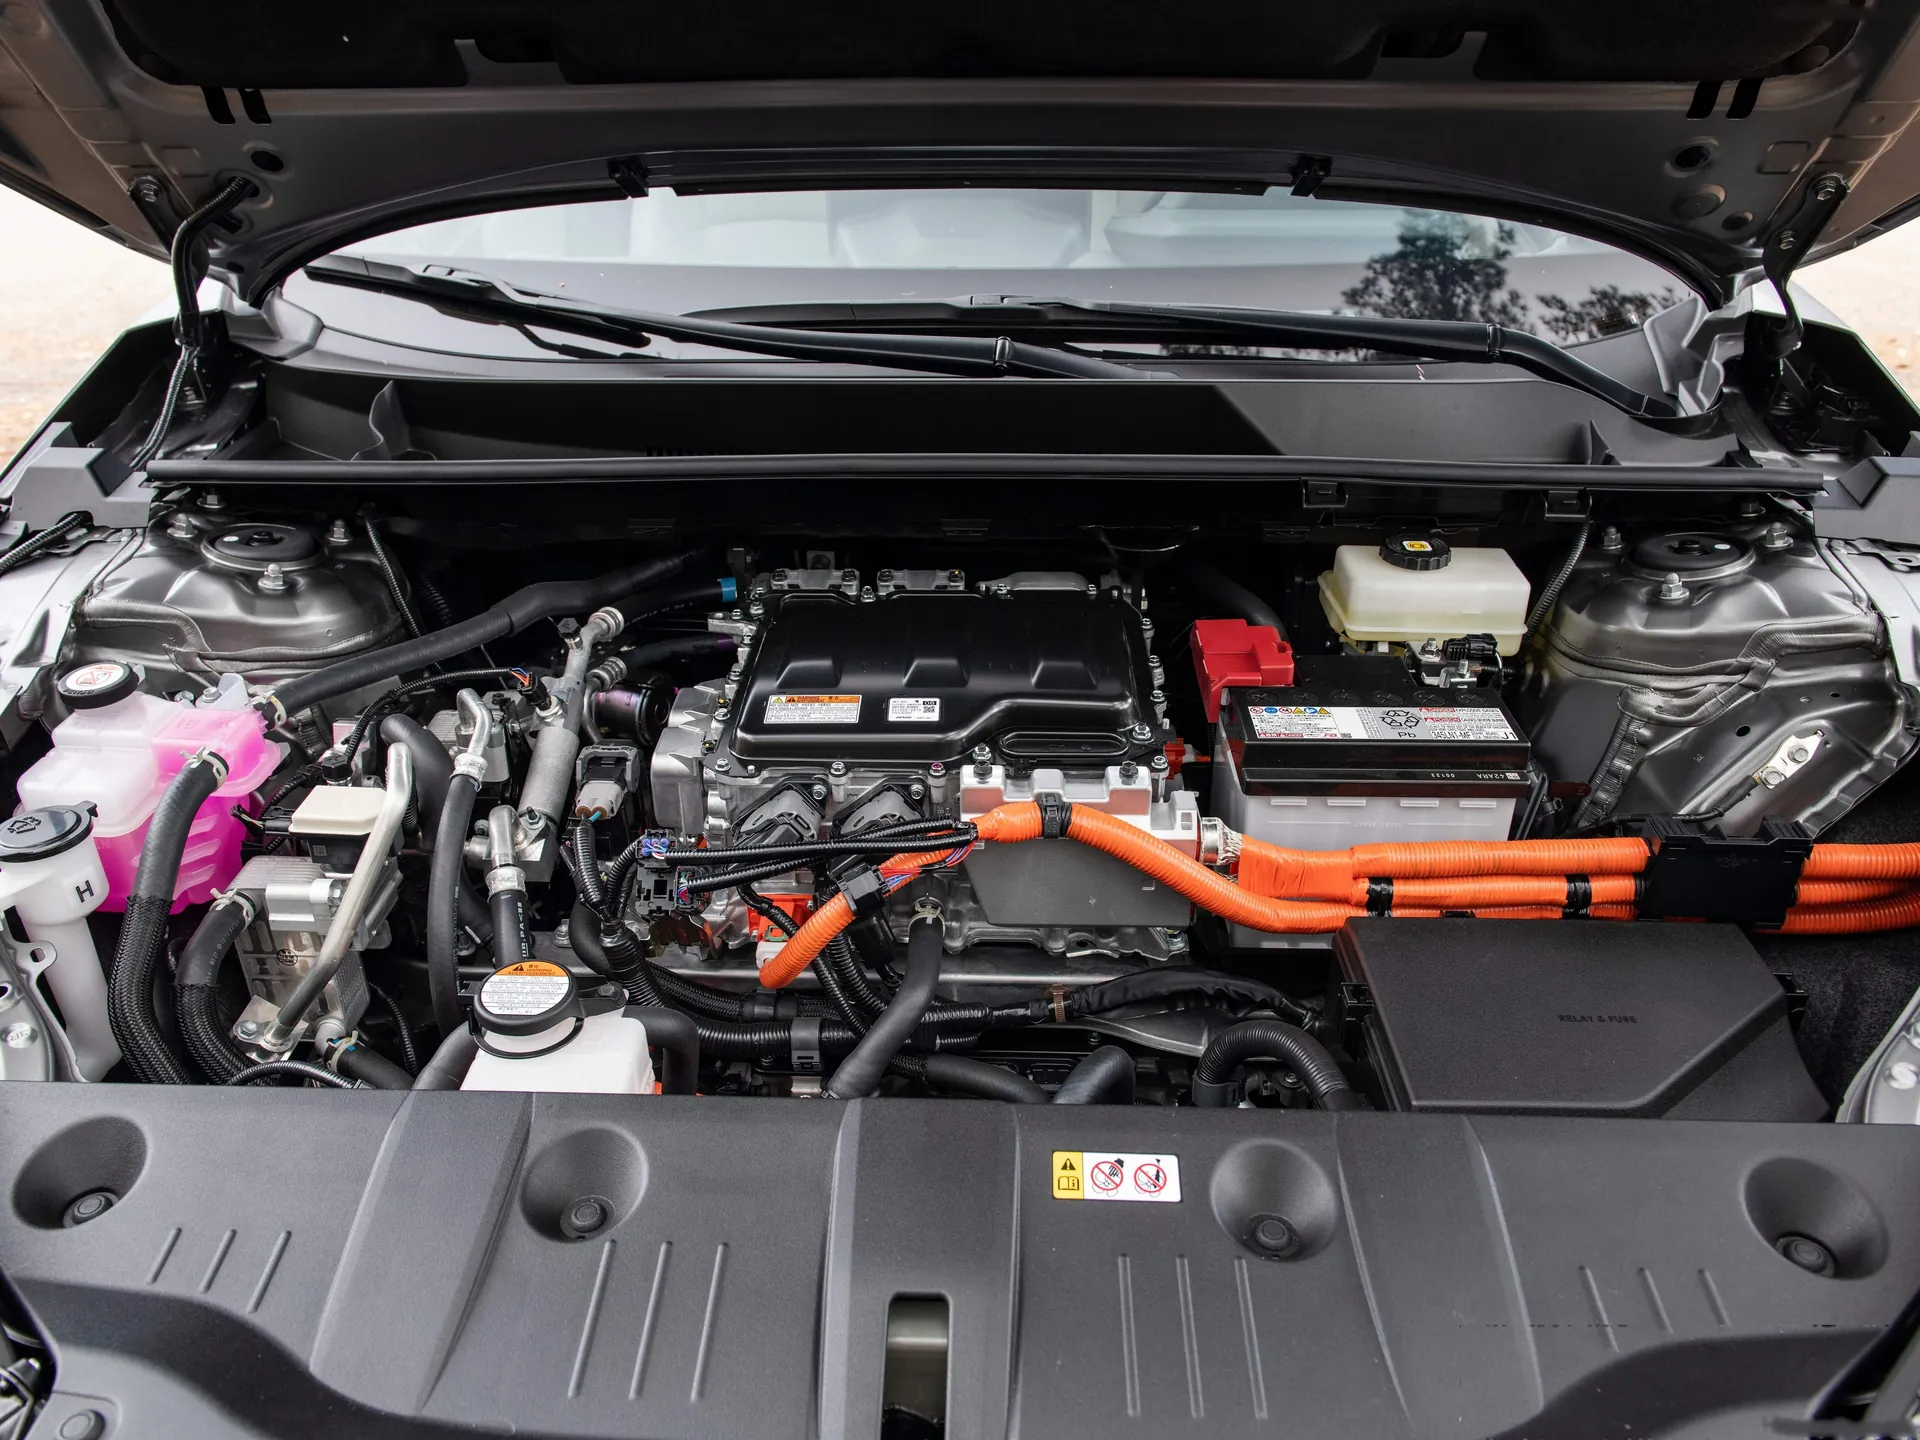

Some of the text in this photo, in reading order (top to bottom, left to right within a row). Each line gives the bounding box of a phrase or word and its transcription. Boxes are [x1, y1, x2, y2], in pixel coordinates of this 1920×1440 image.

[75, 880, 94, 903] H
[1558, 1014, 1638, 1023] RELAY & FUSE
